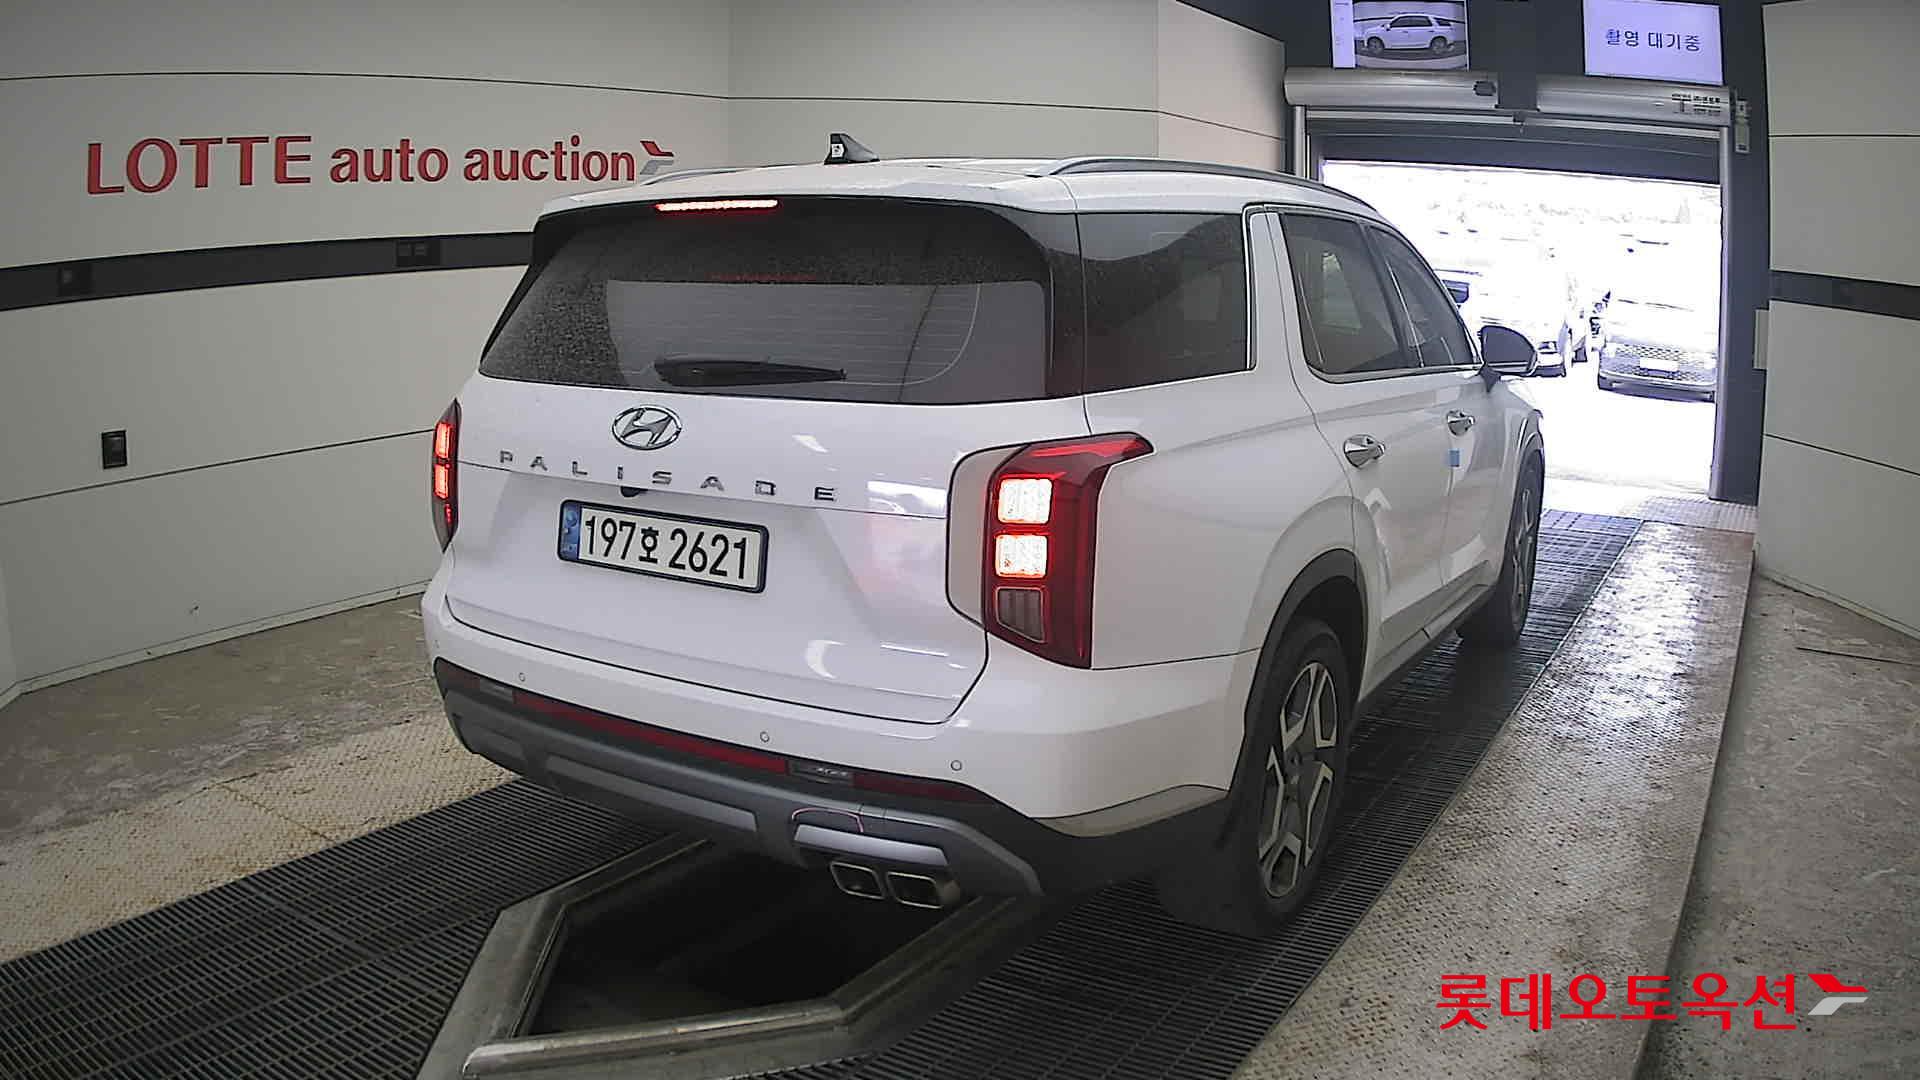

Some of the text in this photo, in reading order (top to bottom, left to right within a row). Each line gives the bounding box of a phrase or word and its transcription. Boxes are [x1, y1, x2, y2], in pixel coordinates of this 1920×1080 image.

[1648, 32, 1700, 51] 대기중
[87, 135, 635, 195] LOTTE auto auction
[499, 450, 835, 501] PALISADE
[584, 515, 748, 580] 197호 2621
